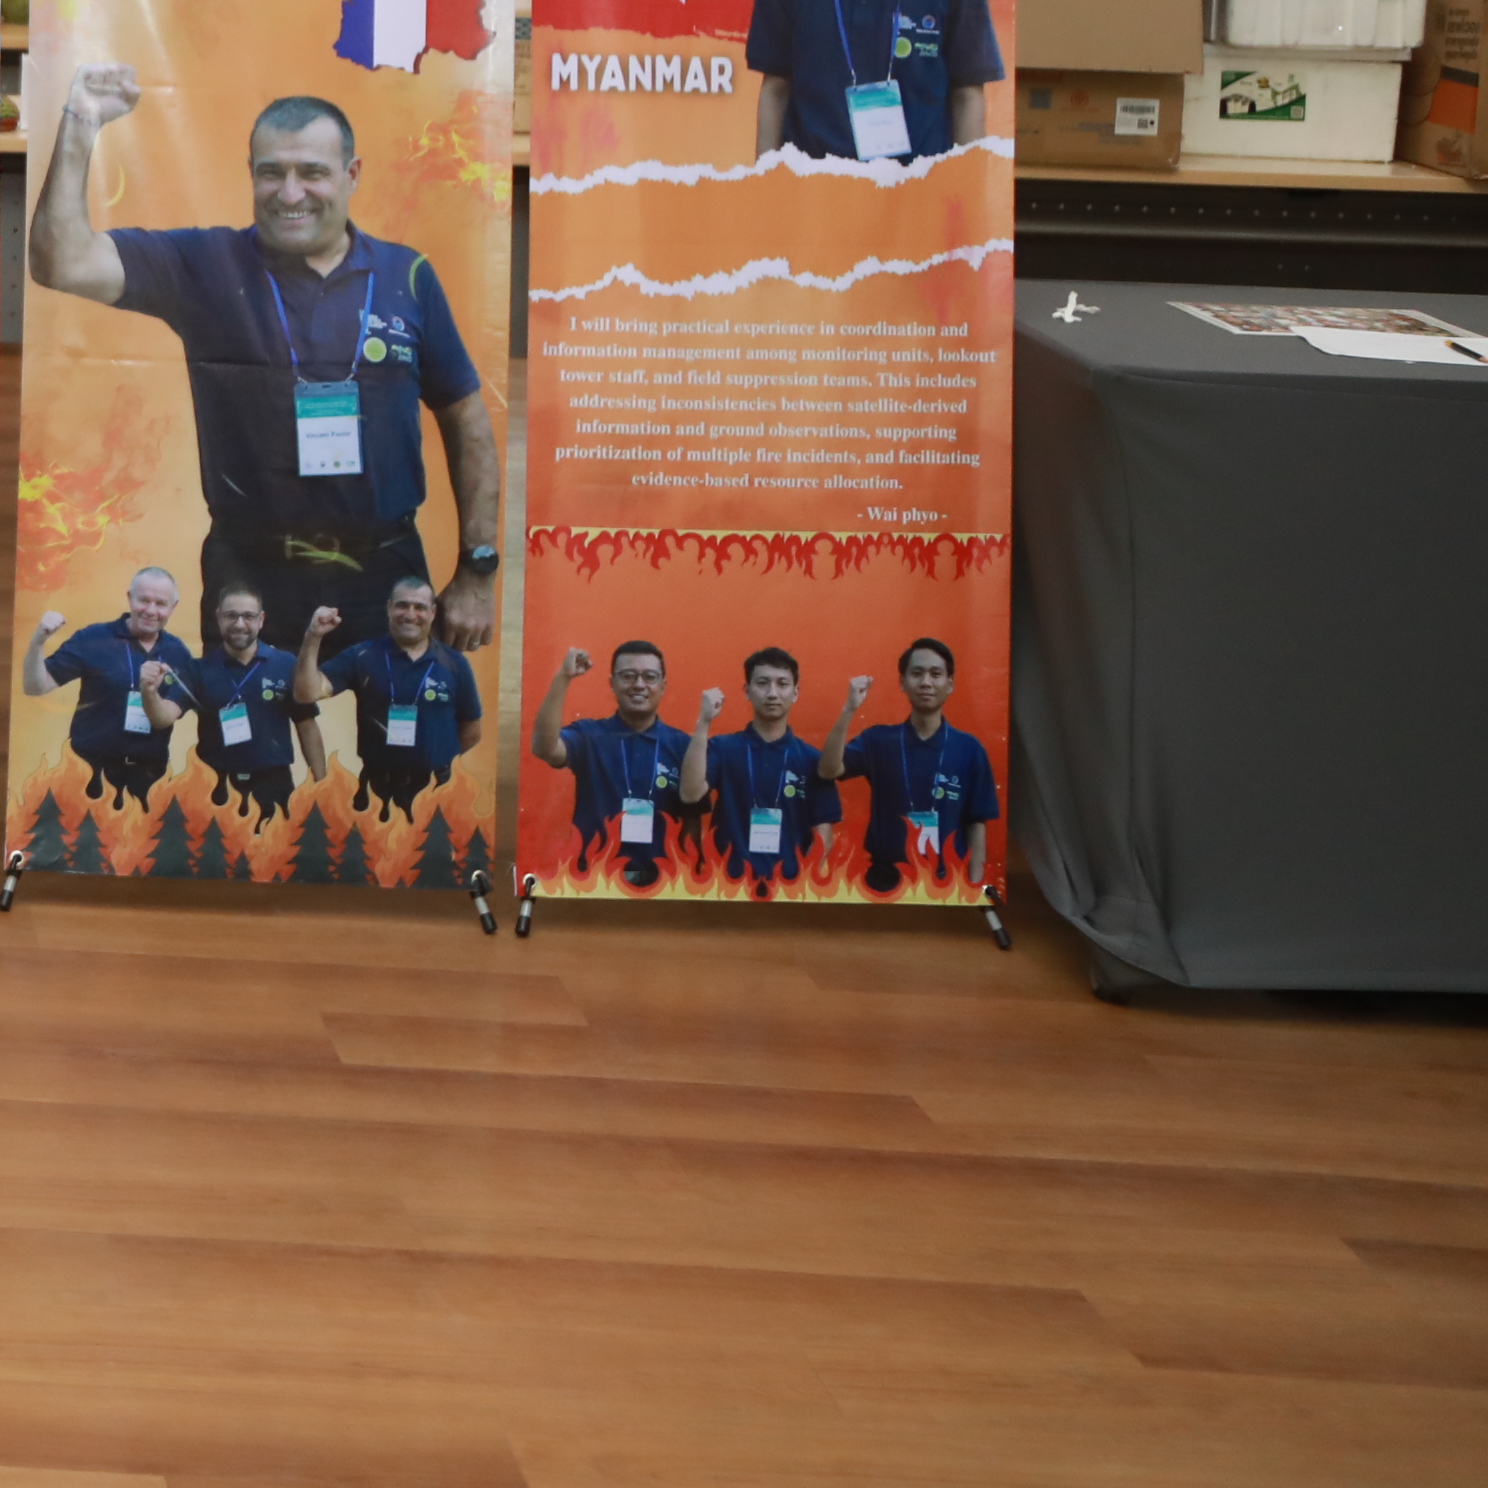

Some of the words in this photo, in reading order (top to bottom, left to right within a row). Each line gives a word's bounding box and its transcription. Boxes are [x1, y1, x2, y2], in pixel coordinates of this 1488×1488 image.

[551, 53, 734, 95] MYANMAR
[570, 316, 577, 332] I
[581, 317, 611, 333] will
[614, 317, 658, 336] bring
[662, 318, 730, 337] practical
[733, 319, 816, 338] experience
[819, 320, 836, 336] in
[839, 321, 936, 338] coordination
[940, 322, 969, 338] and
[631, 471, 750, 488] evidence-based
[753, 477, 820, 489] resource
[823, 474, 903, 490] allocation.
